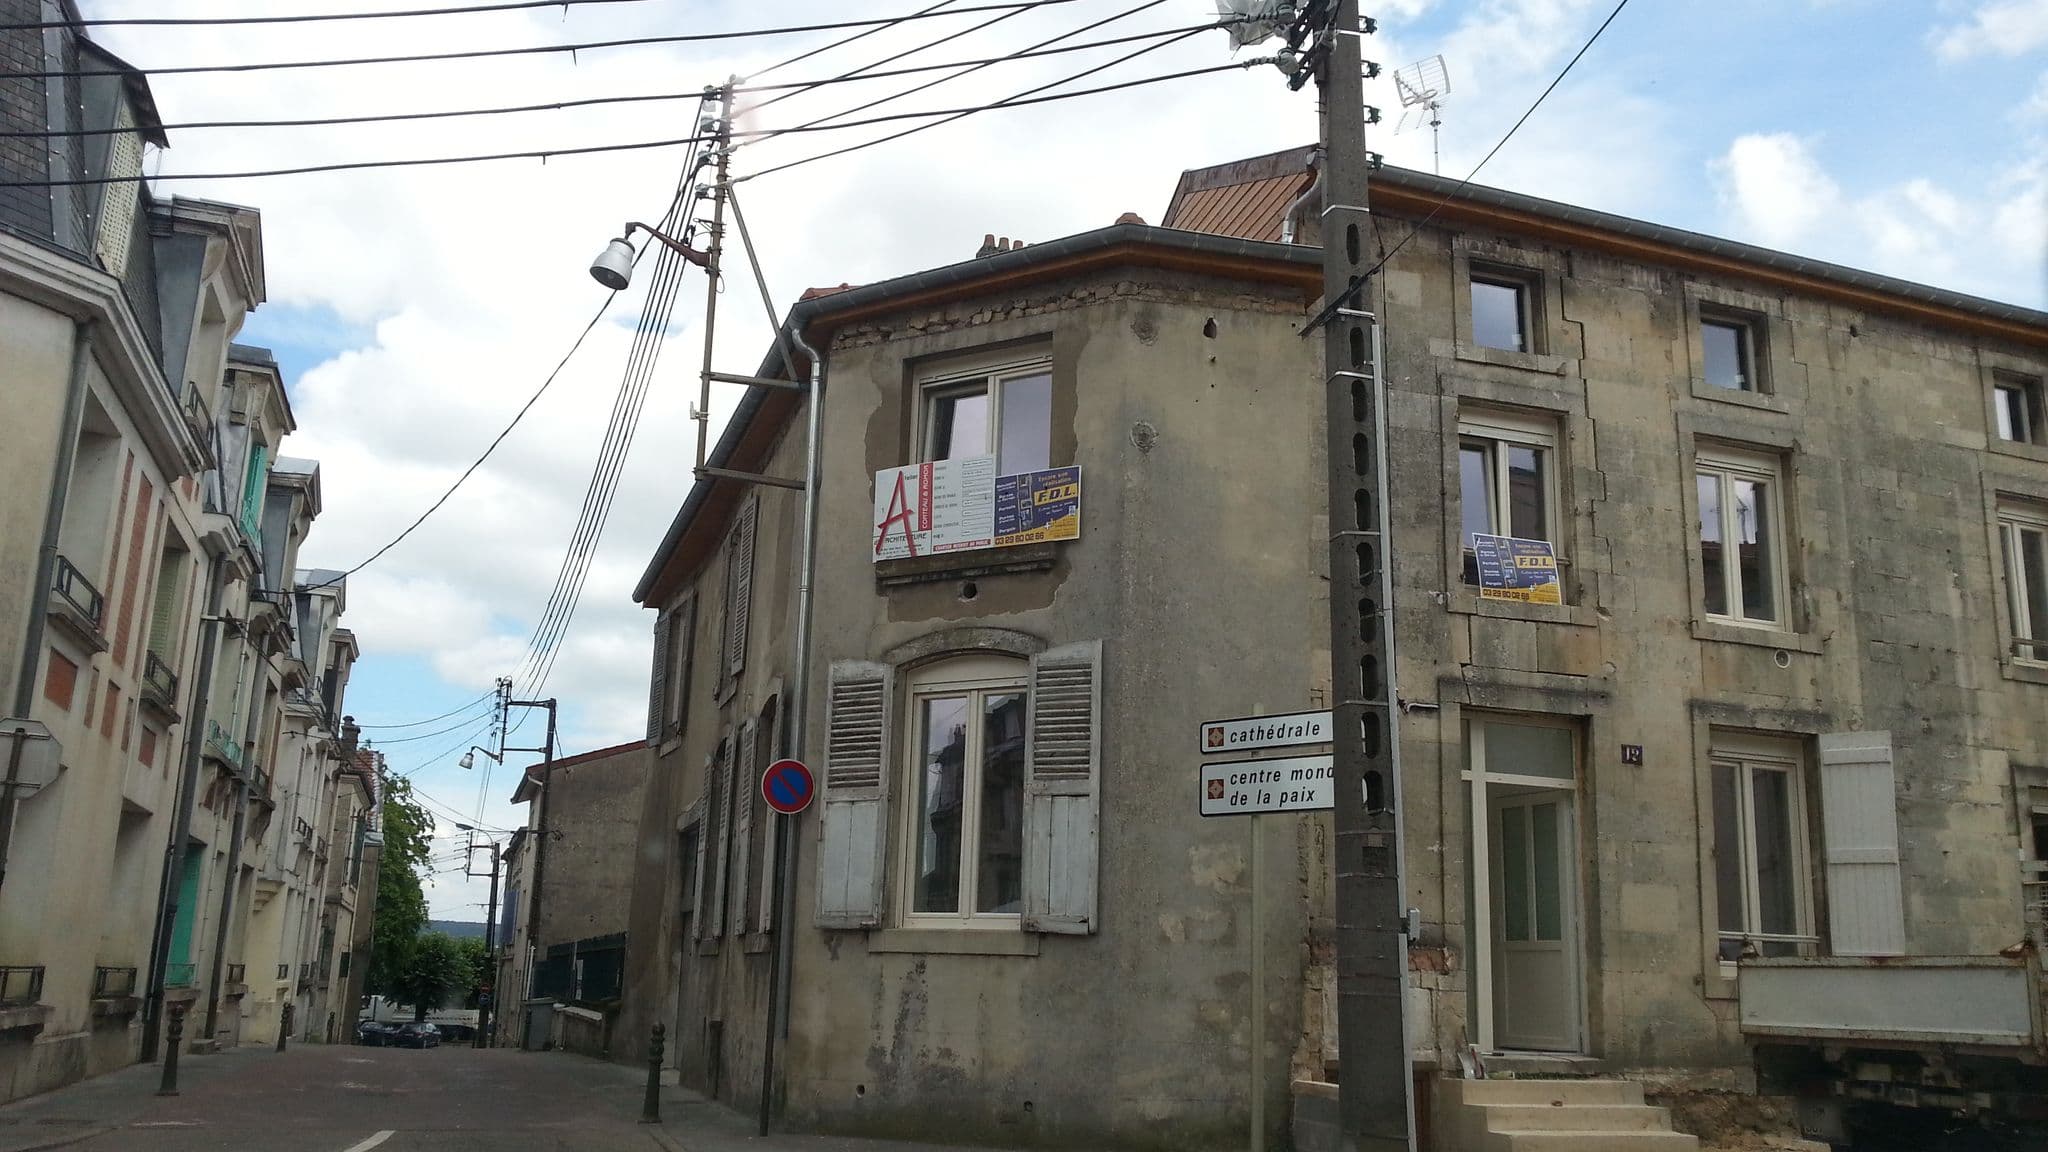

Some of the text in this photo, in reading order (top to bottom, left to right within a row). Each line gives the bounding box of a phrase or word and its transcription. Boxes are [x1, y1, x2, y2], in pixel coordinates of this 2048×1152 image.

[1037, 486, 1076, 503] F.D.L.
[1519, 557, 1552, 567] F.D.L.
[1230, 721, 1320, 743] cathédrale
[1230, 769, 1281, 785] centre
[1230, 786, 1315, 807] de la paix
